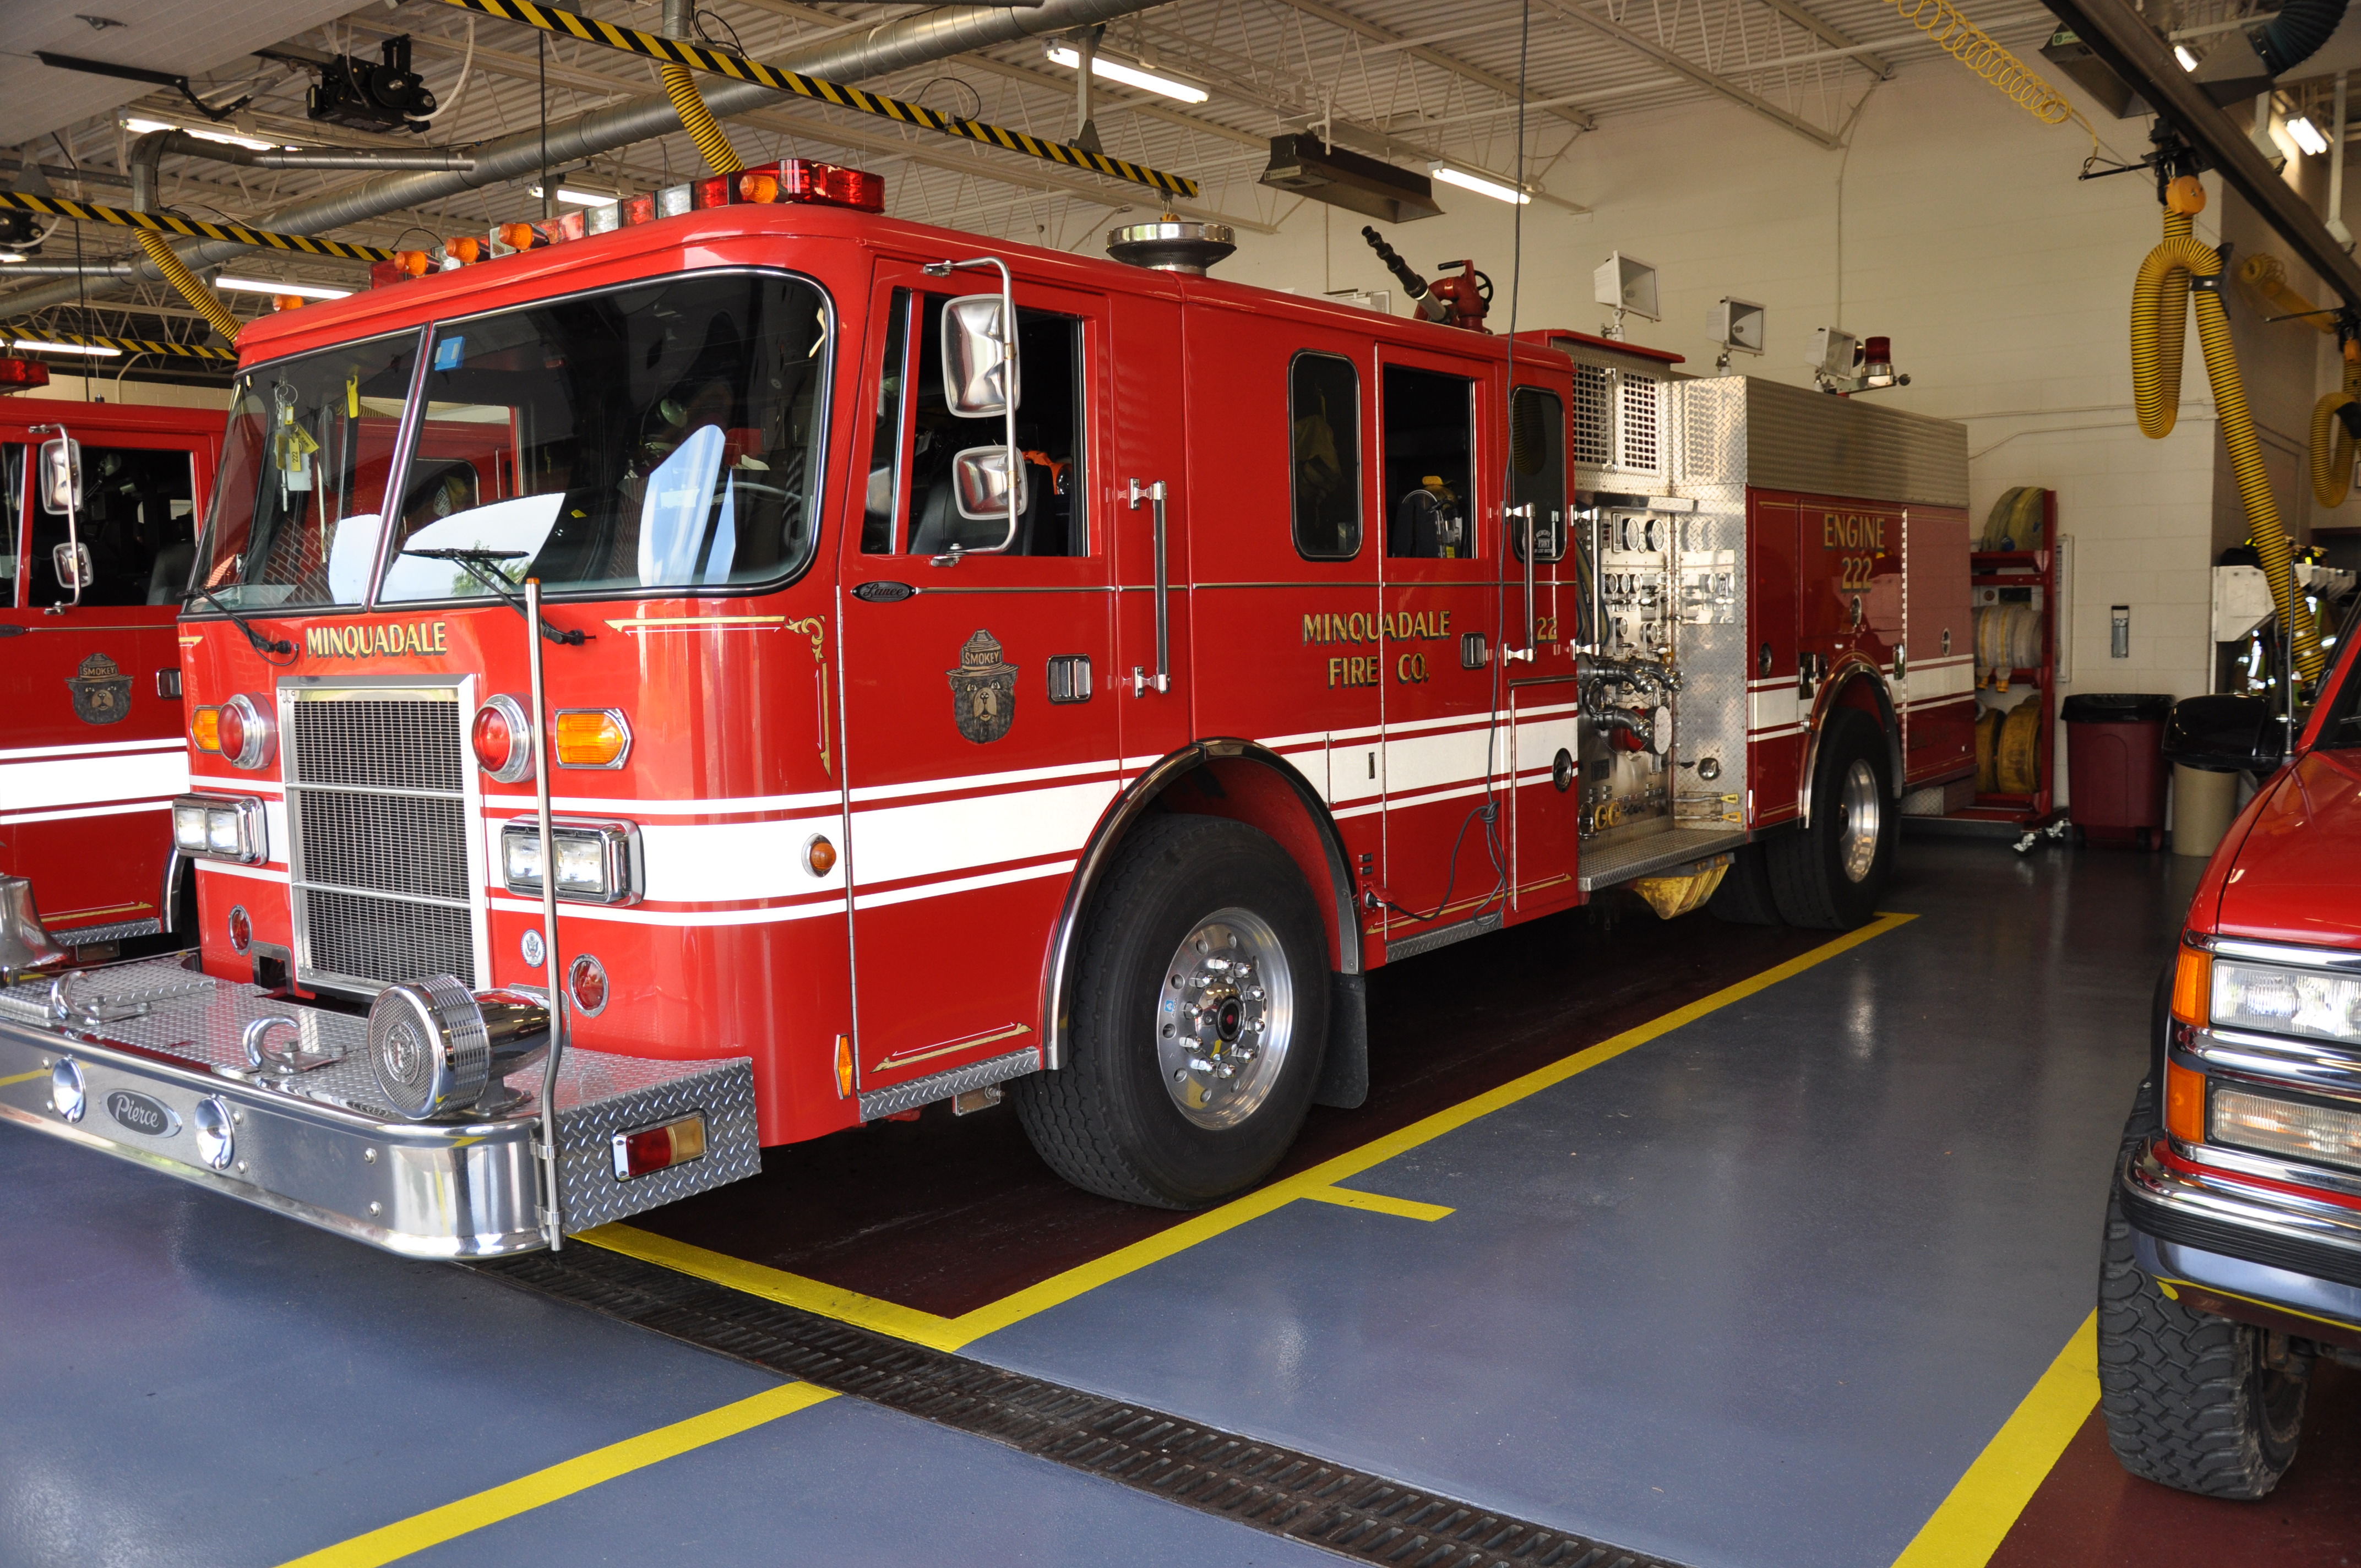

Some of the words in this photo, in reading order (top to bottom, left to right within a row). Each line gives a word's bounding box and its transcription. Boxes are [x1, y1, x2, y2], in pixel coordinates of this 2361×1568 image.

[1824, 513, 1885, 552] ENGINE
[862, 583, 903, 598] Lance
[1841, 557, 1872, 592] 222
[307, 621, 447, 660] MINQUADALE
[1302, 610, 1451, 646] MINQUADALE
[83, 666, 116, 676] SMOKEY
[965, 651, 999, 665] SMOKEY
[1328, 655, 1379, 689] FIRE
[1397, 652, 1430, 684] CO.
[115, 1094, 160, 1128] Pierce
